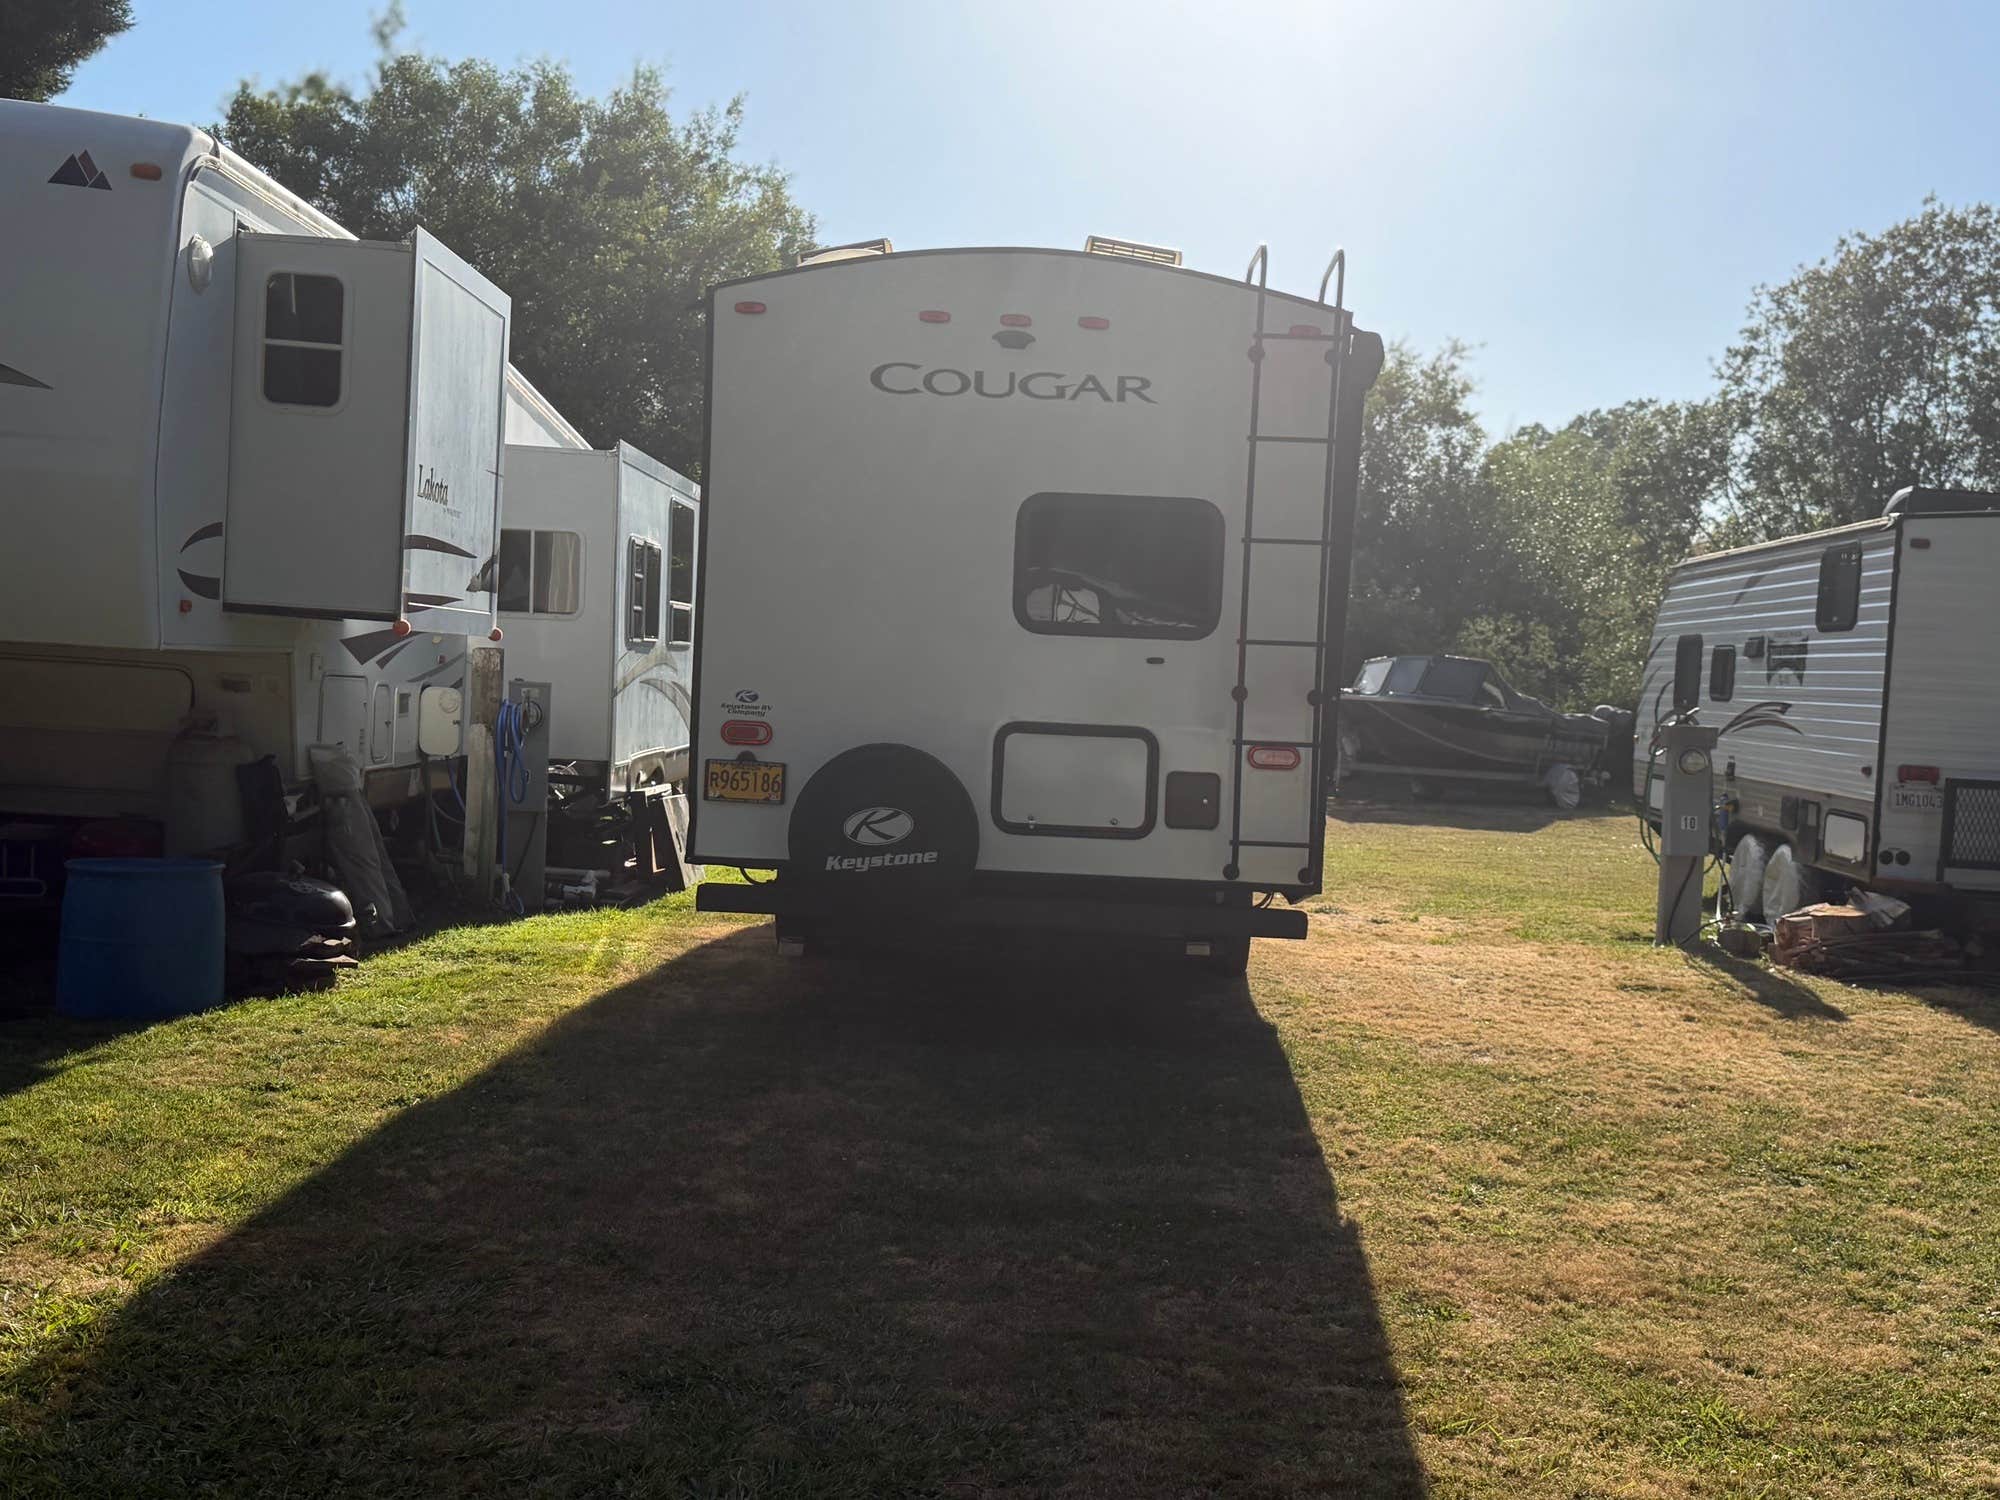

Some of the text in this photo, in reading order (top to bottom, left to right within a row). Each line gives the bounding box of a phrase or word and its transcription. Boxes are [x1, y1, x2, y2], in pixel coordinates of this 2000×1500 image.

[870, 362, 1159, 405] COUGAR
[417, 464, 448, 506] Lakota
[709, 769, 781, 793] R965186
[1684, 816, 1697, 830] 10
[825, 851, 938, 872] Keystone
